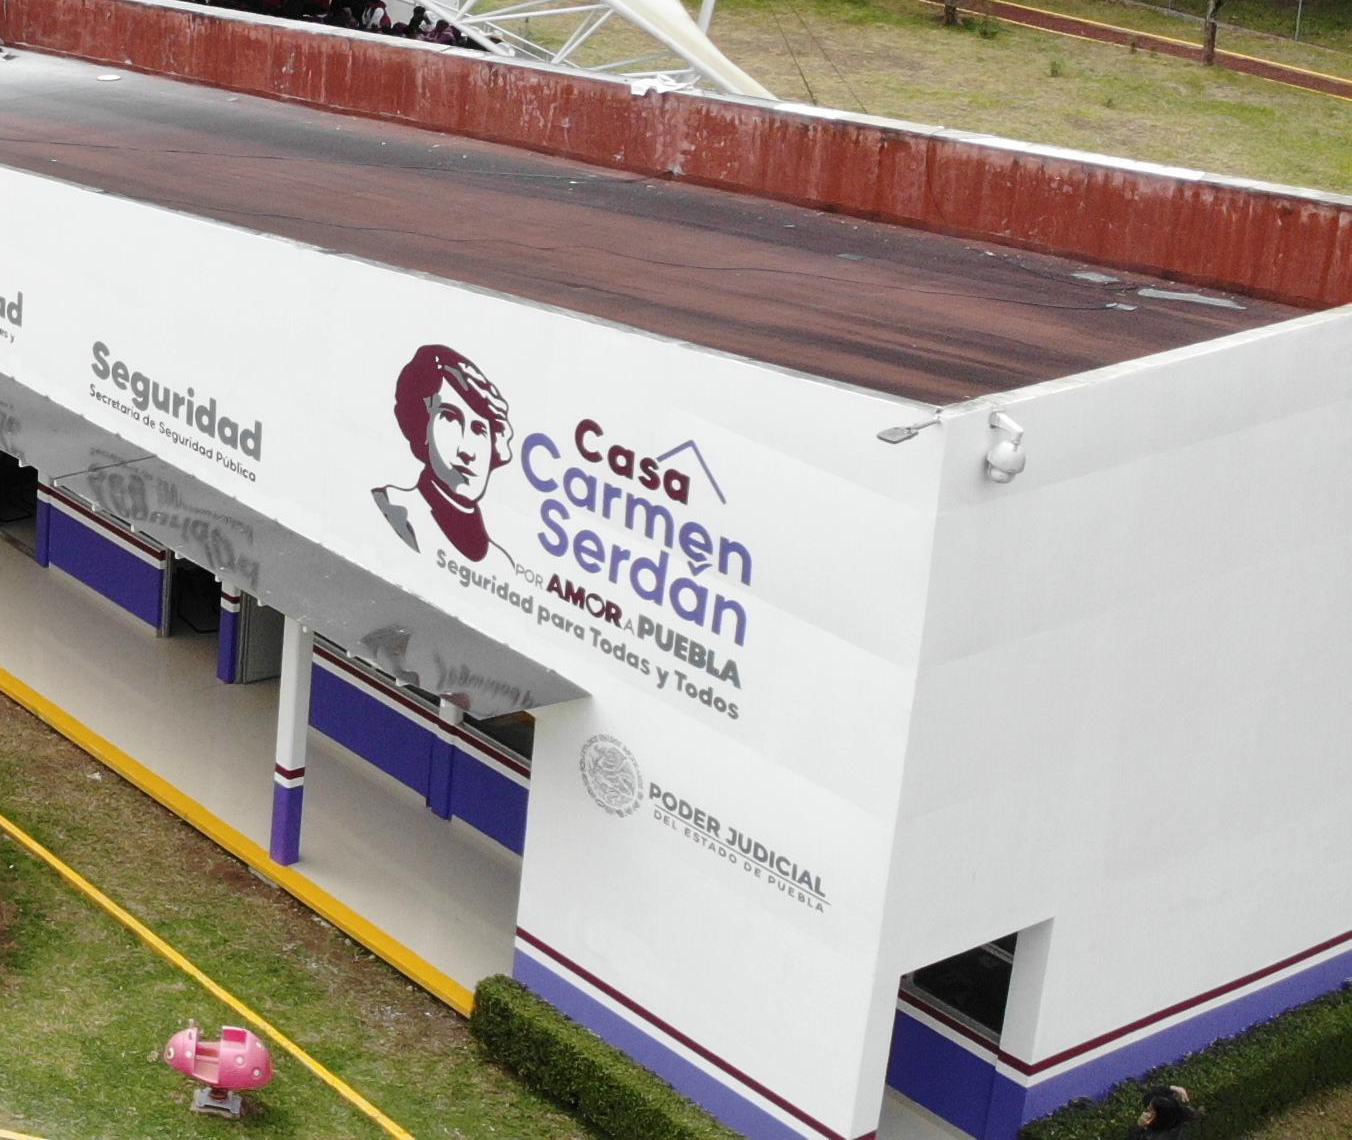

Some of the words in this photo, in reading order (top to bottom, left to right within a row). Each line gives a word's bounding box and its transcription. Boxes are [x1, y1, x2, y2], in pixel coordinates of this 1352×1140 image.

[91, 340, 263, 462] Seguridad
[142, 413, 157, 430] de
[158, 421, 214, 460] Seguridad
[215, 450, 257, 483] Pública
[575, 418, 691, 506] Casa
[521, 432, 753, 587] Carmen
[436, 548, 534, 615] Seguridad
[536, 605, 586, 641] para
[589, 625, 651, 676] Todas
[655, 664, 670, 690] y
[674, 670, 740, 720] Todos
[515, 563, 544, 590] POR
[546, 573, 624, 629] AMOR
[623, 617, 636, 637] A
[637, 613, 742, 690] PUEBLA
[537, 498, 748, 648] Serdán
[648, 781, 721, 839] PODER
[726, 826, 827, 898] JUDICIAL
[653, 809, 678, 831] DEL
[684, 827, 737, 865] ESTADO
[743, 861, 762, 879] DE
[767, 874, 825, 914] PUEBLA
